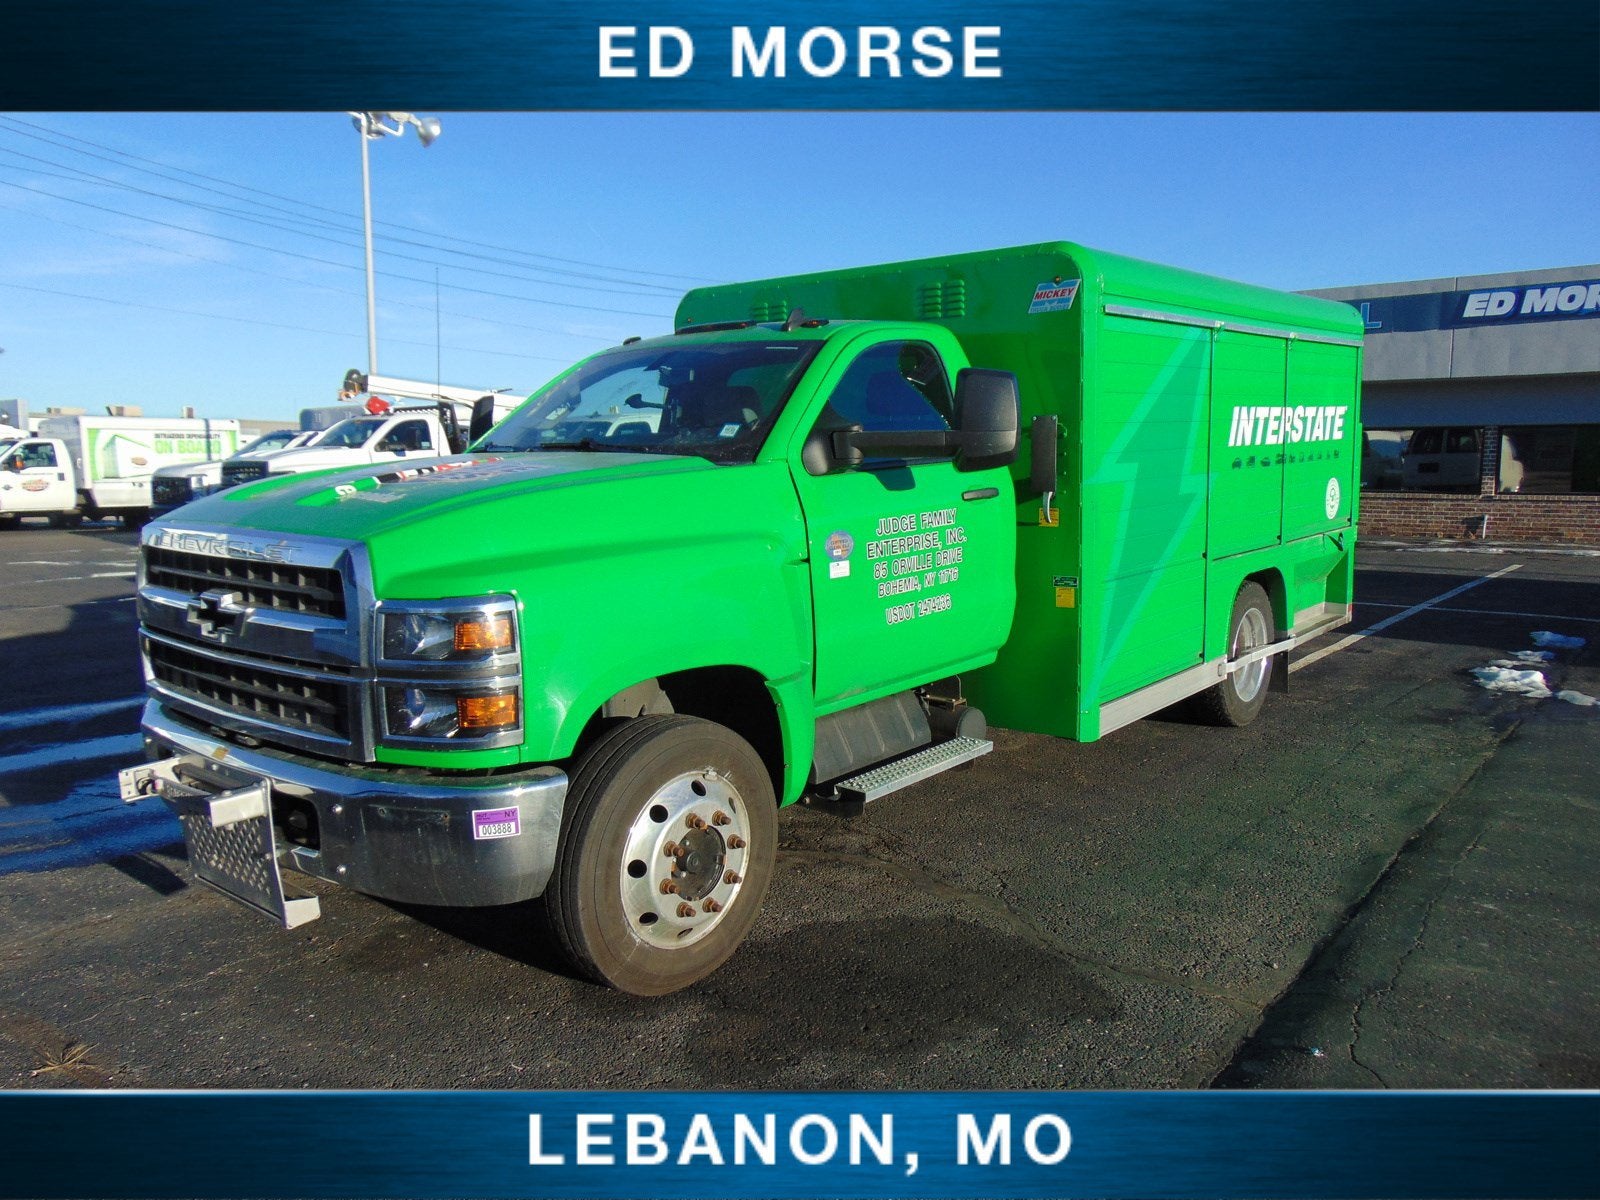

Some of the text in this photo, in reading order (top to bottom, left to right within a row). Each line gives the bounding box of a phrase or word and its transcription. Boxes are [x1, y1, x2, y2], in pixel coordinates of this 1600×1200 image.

[1034, 287, 1075, 300] MICKEY
[1462, 291, 1516, 318] ED
[1228, 405, 1348, 447] INTERSTATE
[155, 440, 173, 454] ON
[876, 508, 957, 536] JUDGE FAMILY
[160, 532, 302, 563] CHEVROLET
[867, 527, 967, 560] ENTERPRISE, INC.
[874, 547, 962, 580] 85 ORVILLE DRIVE
[878, 567, 958, 598] BOHEMIA, NY 11716
[886, 602, 915, 625] USDOT
[504, 810, 516, 818] NY
[482, 823, 512, 835] 003888
